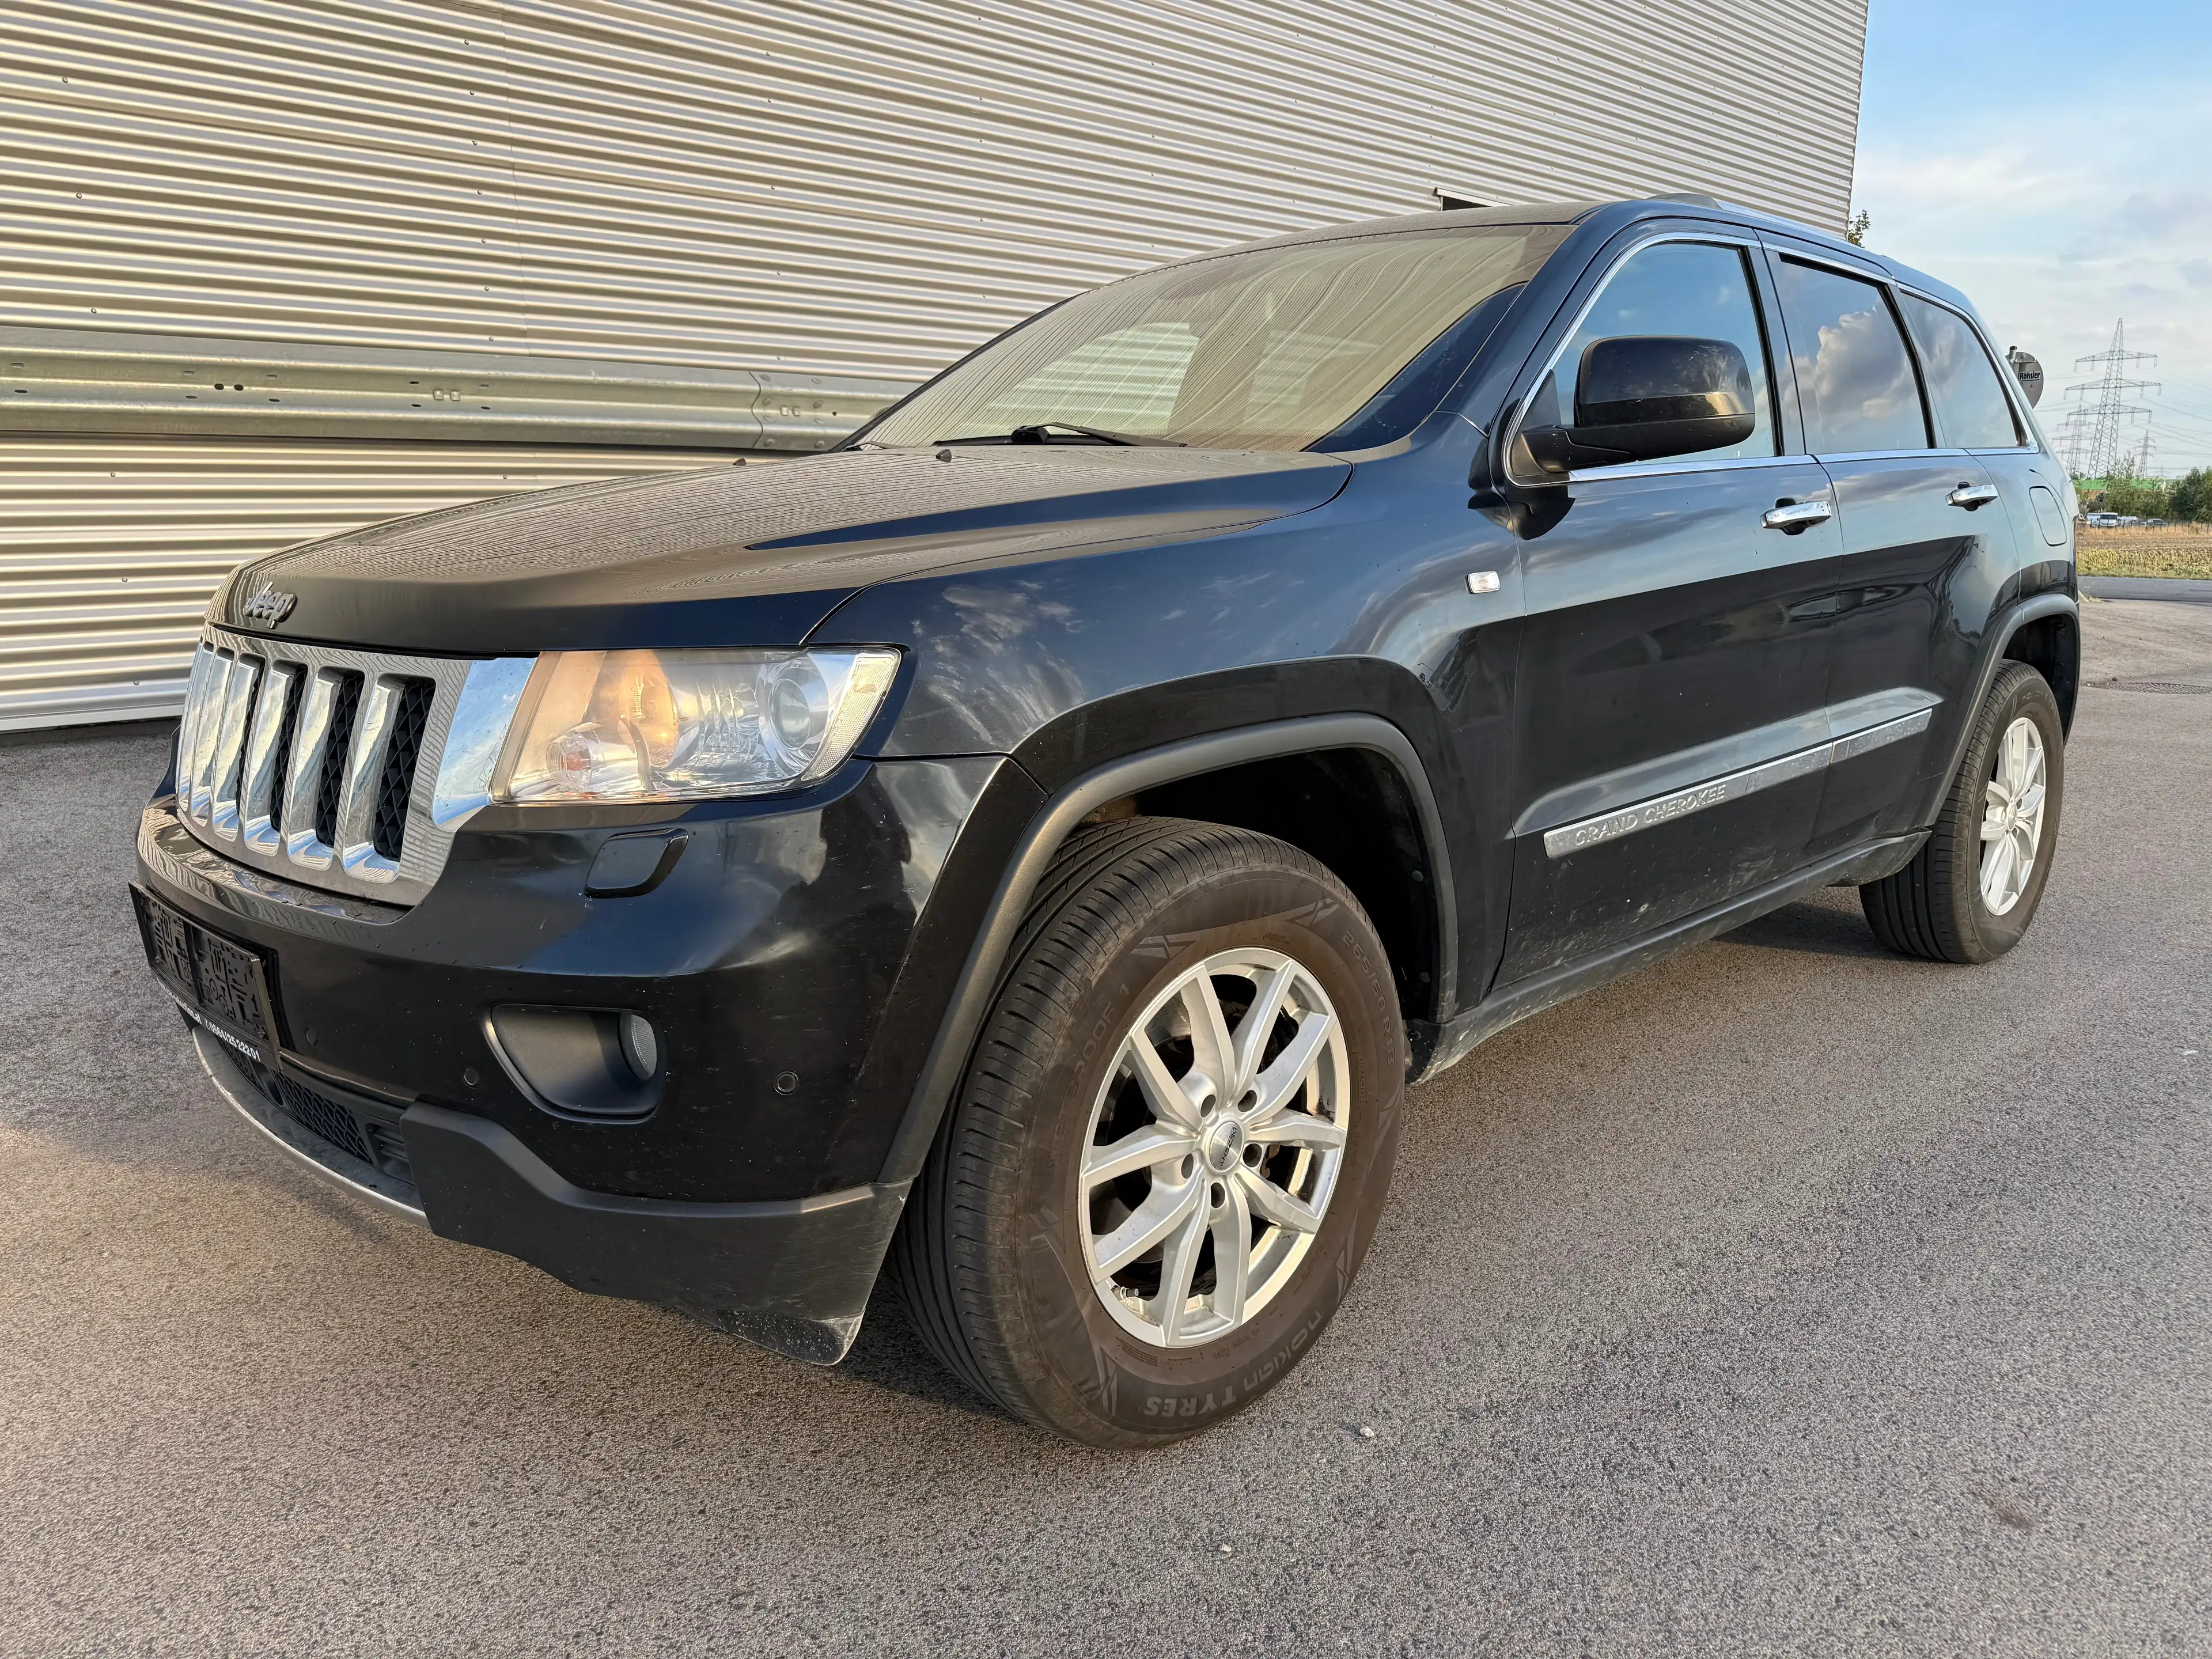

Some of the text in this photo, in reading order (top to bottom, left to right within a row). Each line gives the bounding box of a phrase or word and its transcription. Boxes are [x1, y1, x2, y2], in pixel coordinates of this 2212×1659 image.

[243, 581, 296, 628] Jeep
[1574, 784, 1726, 846] GRAND CHEROKEE
[1219, 1126, 1237, 1166] DEZENT
[1143, 1385, 1237, 1417] TYRES
